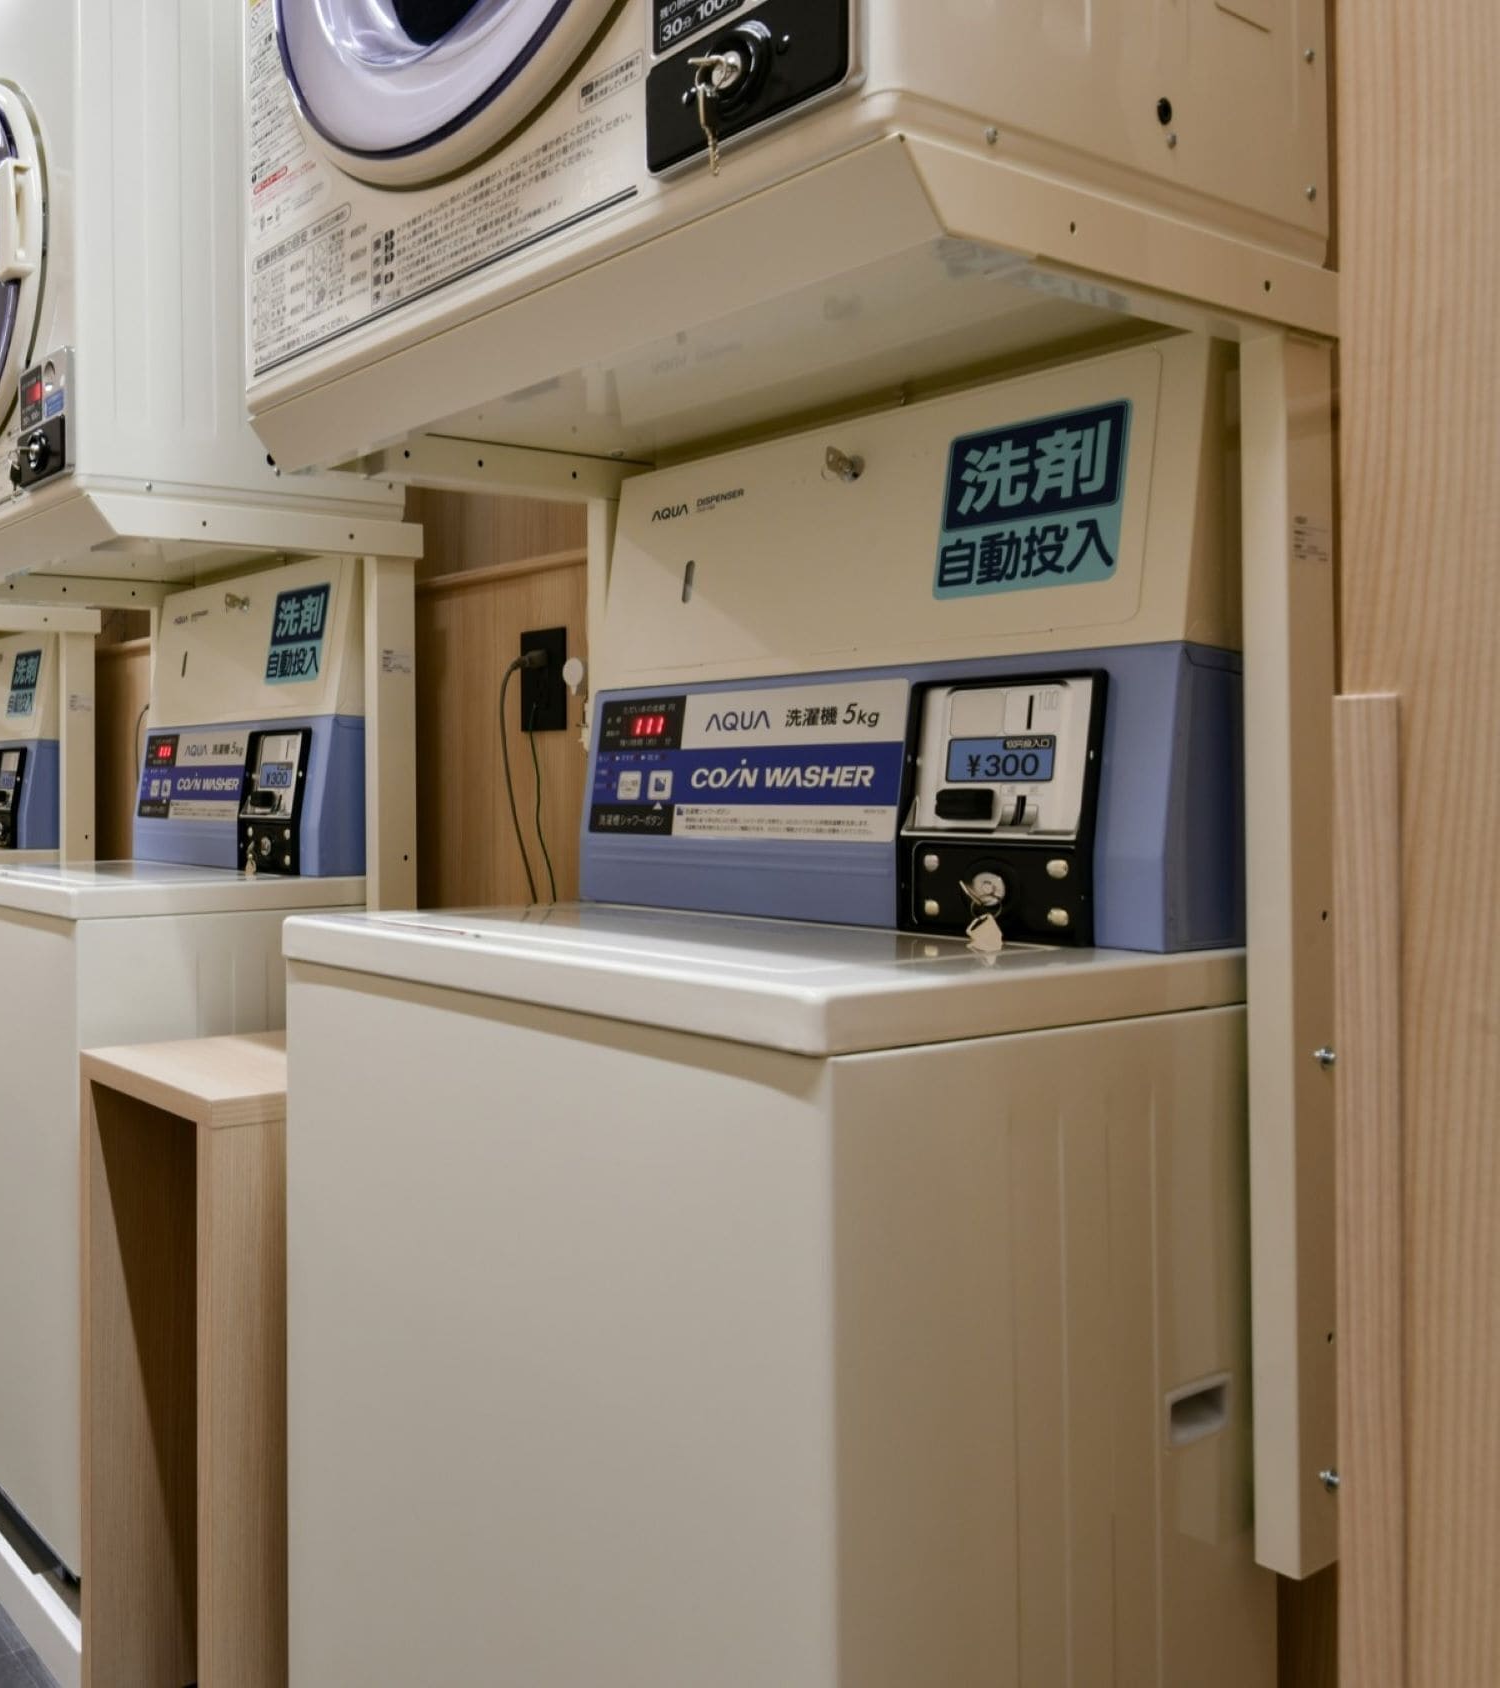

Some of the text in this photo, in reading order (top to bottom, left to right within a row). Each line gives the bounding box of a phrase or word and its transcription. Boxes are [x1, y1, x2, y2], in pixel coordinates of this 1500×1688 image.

[957, 420, 1111, 515] 洗剤
[651, 504, 688, 522] AQUA
[696, 488, 745, 507] DISPENSER
[938, 519, 1114, 587] 自動投入
[276, 592, 323, 636] 洗剤
[265, 647, 319, 680] 自動投入
[705, 703, 880, 732] AQUA 洗濯機 5kg
[185, 743, 209, 757] AQUA
[966, 753, 1040, 778] ¥300
[177, 772, 240, 792] COIN WASHER
[691, 758, 875, 789] COIN WASHER
